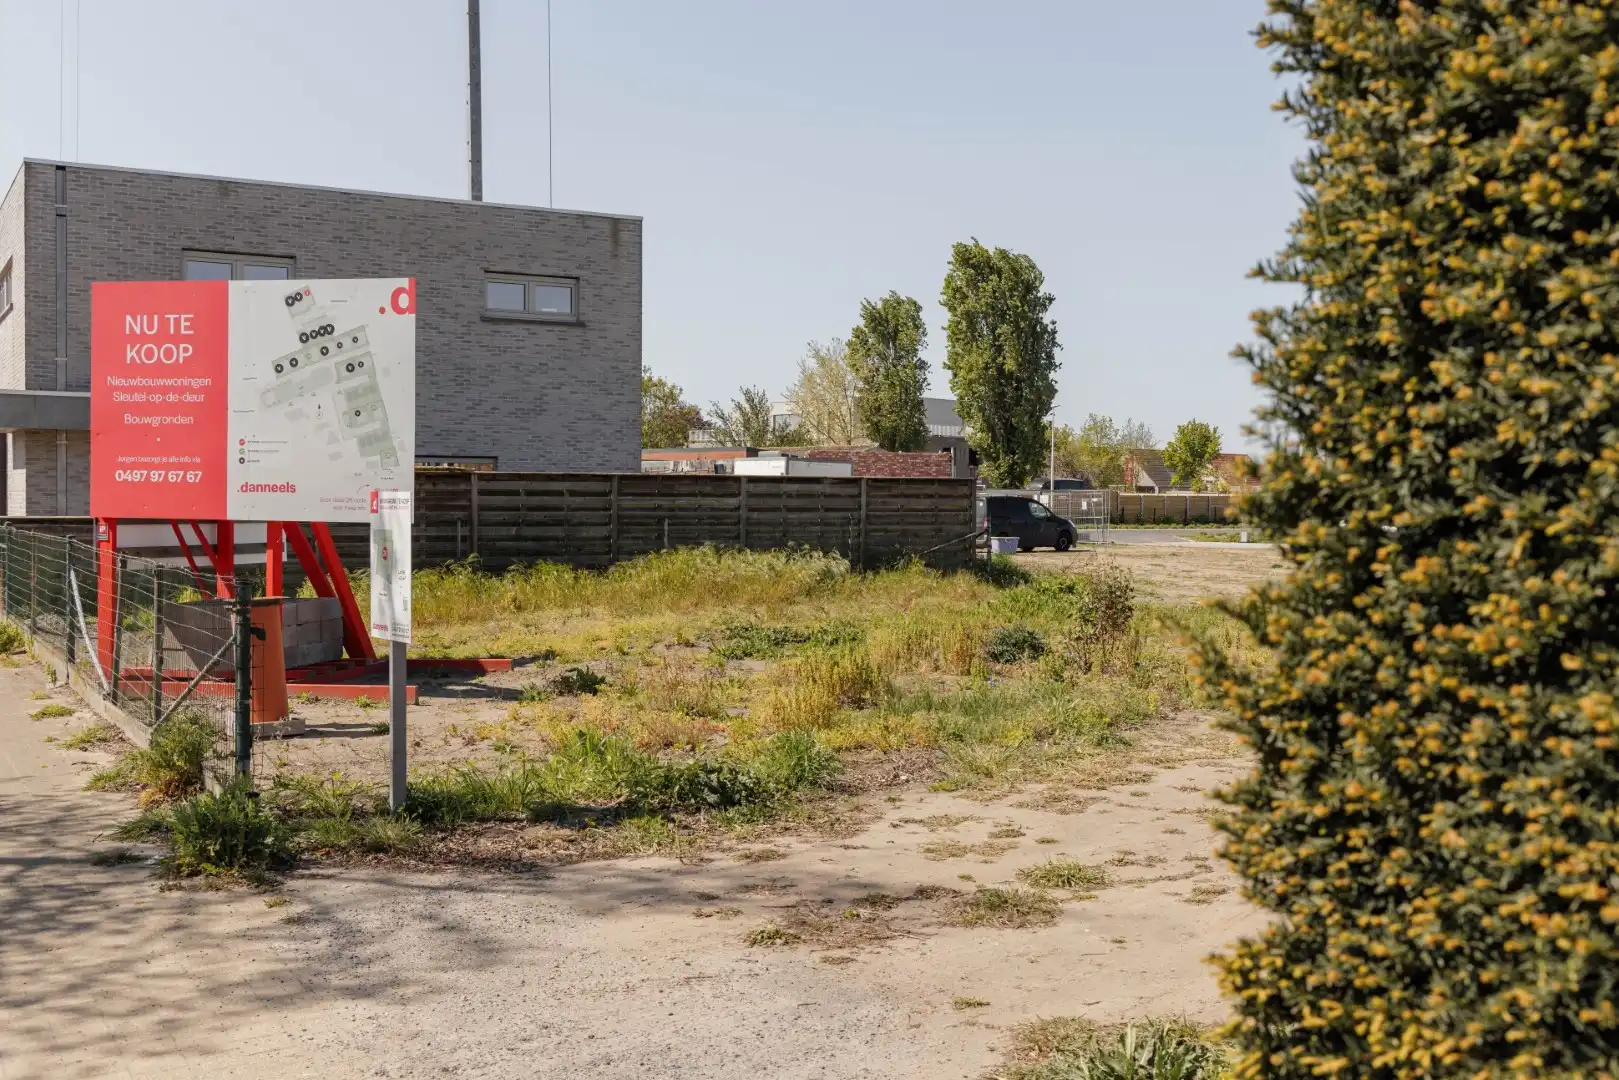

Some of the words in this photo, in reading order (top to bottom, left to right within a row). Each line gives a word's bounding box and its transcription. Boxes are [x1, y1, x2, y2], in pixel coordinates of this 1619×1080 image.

[125, 314, 158, 335] NU
[164, 314, 195, 335] TE
[126, 343, 194, 365] KOOP
[106, 375, 212, 389] Nieuwbouwwoningen
[113, 391, 205, 404] Sleutel-op-de-deur
[124, 413, 194, 428] Bouwgronden
[180, 455, 192, 463] info
[192, 455, 201, 463] via
[115, 470, 148, 482] 0497
[150, 470, 166, 482] 97
[168, 470, 184, 483] 67
[186, 471, 203, 483] 67
